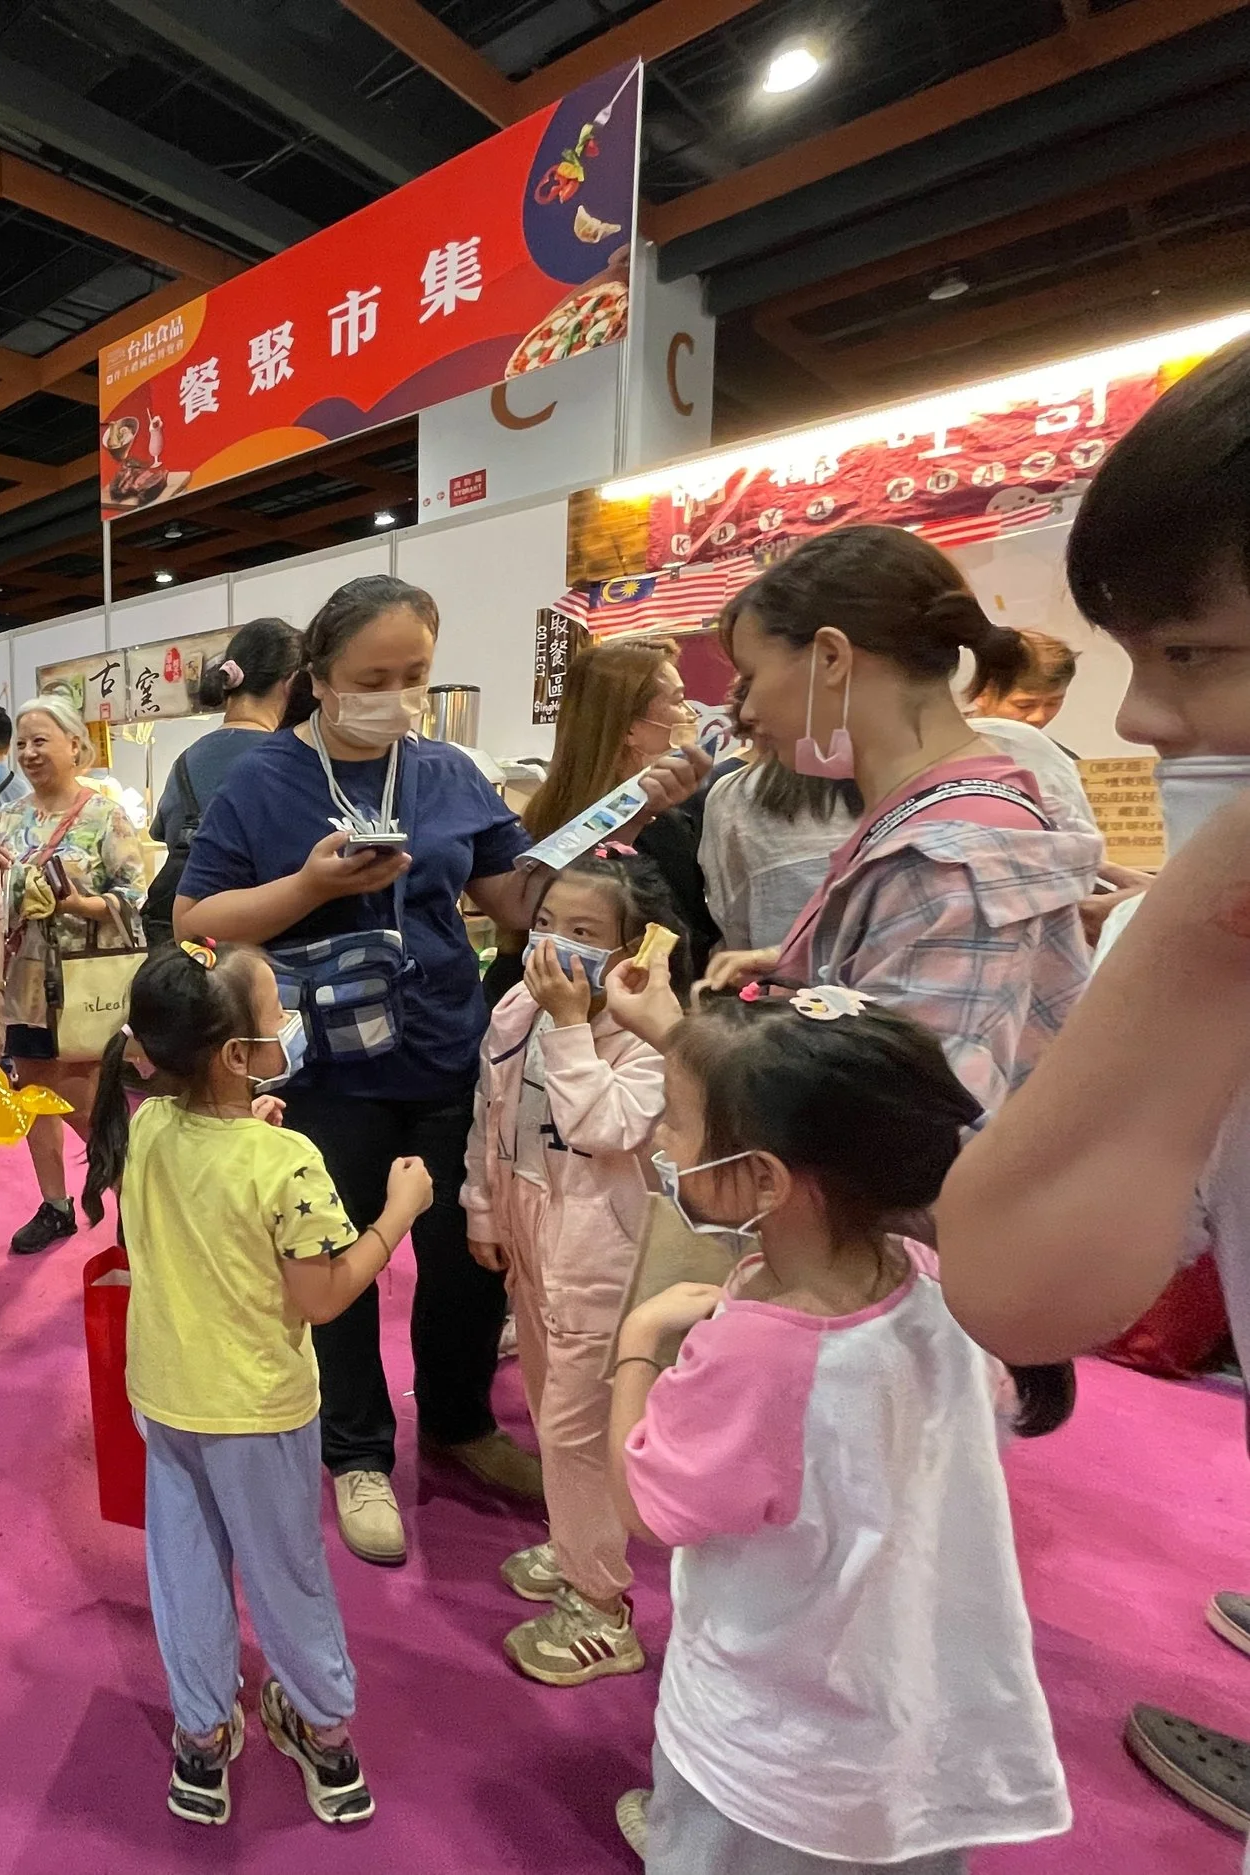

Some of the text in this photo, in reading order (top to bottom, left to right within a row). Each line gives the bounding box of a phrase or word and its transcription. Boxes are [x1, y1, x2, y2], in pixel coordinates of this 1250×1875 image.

[127, 315, 184, 361] 台北食品
[178, 235, 485, 425] 餐聚市集
[667, 331, 695, 416] C
[674, 500, 831, 553] KAYA
[535, 625, 548, 677] COLLECT
[548, 613, 569, 698] 取餐區
